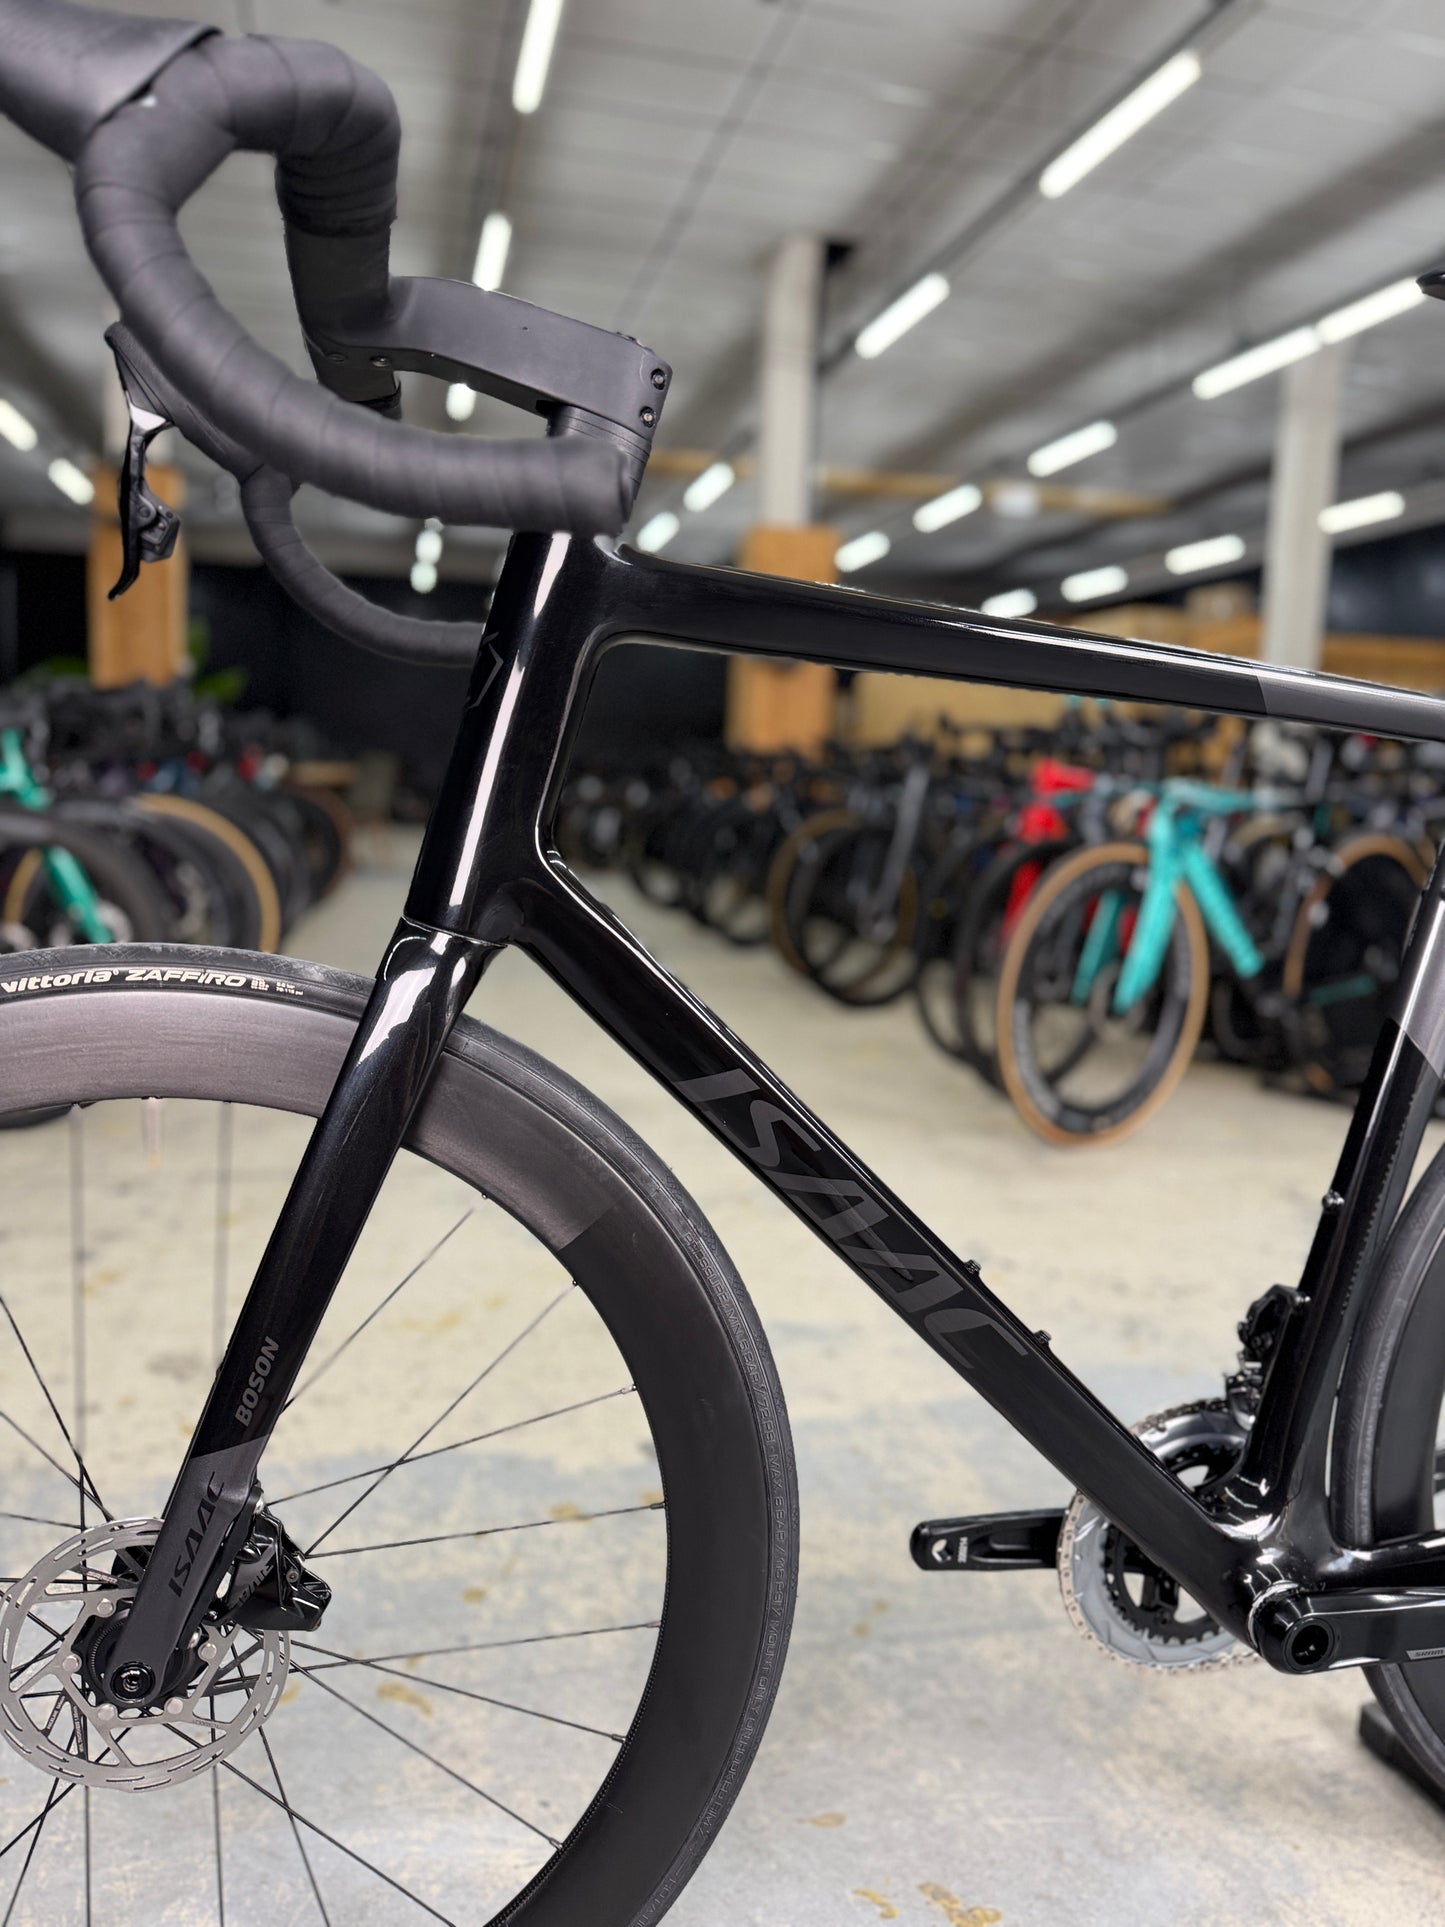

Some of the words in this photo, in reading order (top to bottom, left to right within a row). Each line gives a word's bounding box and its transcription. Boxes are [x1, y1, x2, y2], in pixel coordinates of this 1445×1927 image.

[125, 968, 247, 987] ZAFFIRO
[677, 1068, 1028, 1370] ISAAC
[234, 1335, 280, 1428] BOSON
[755, 1395, 771, 1419] 72
[761, 1419, 776, 1443] PSI
[168, 1471, 225, 1598] ISAAC
